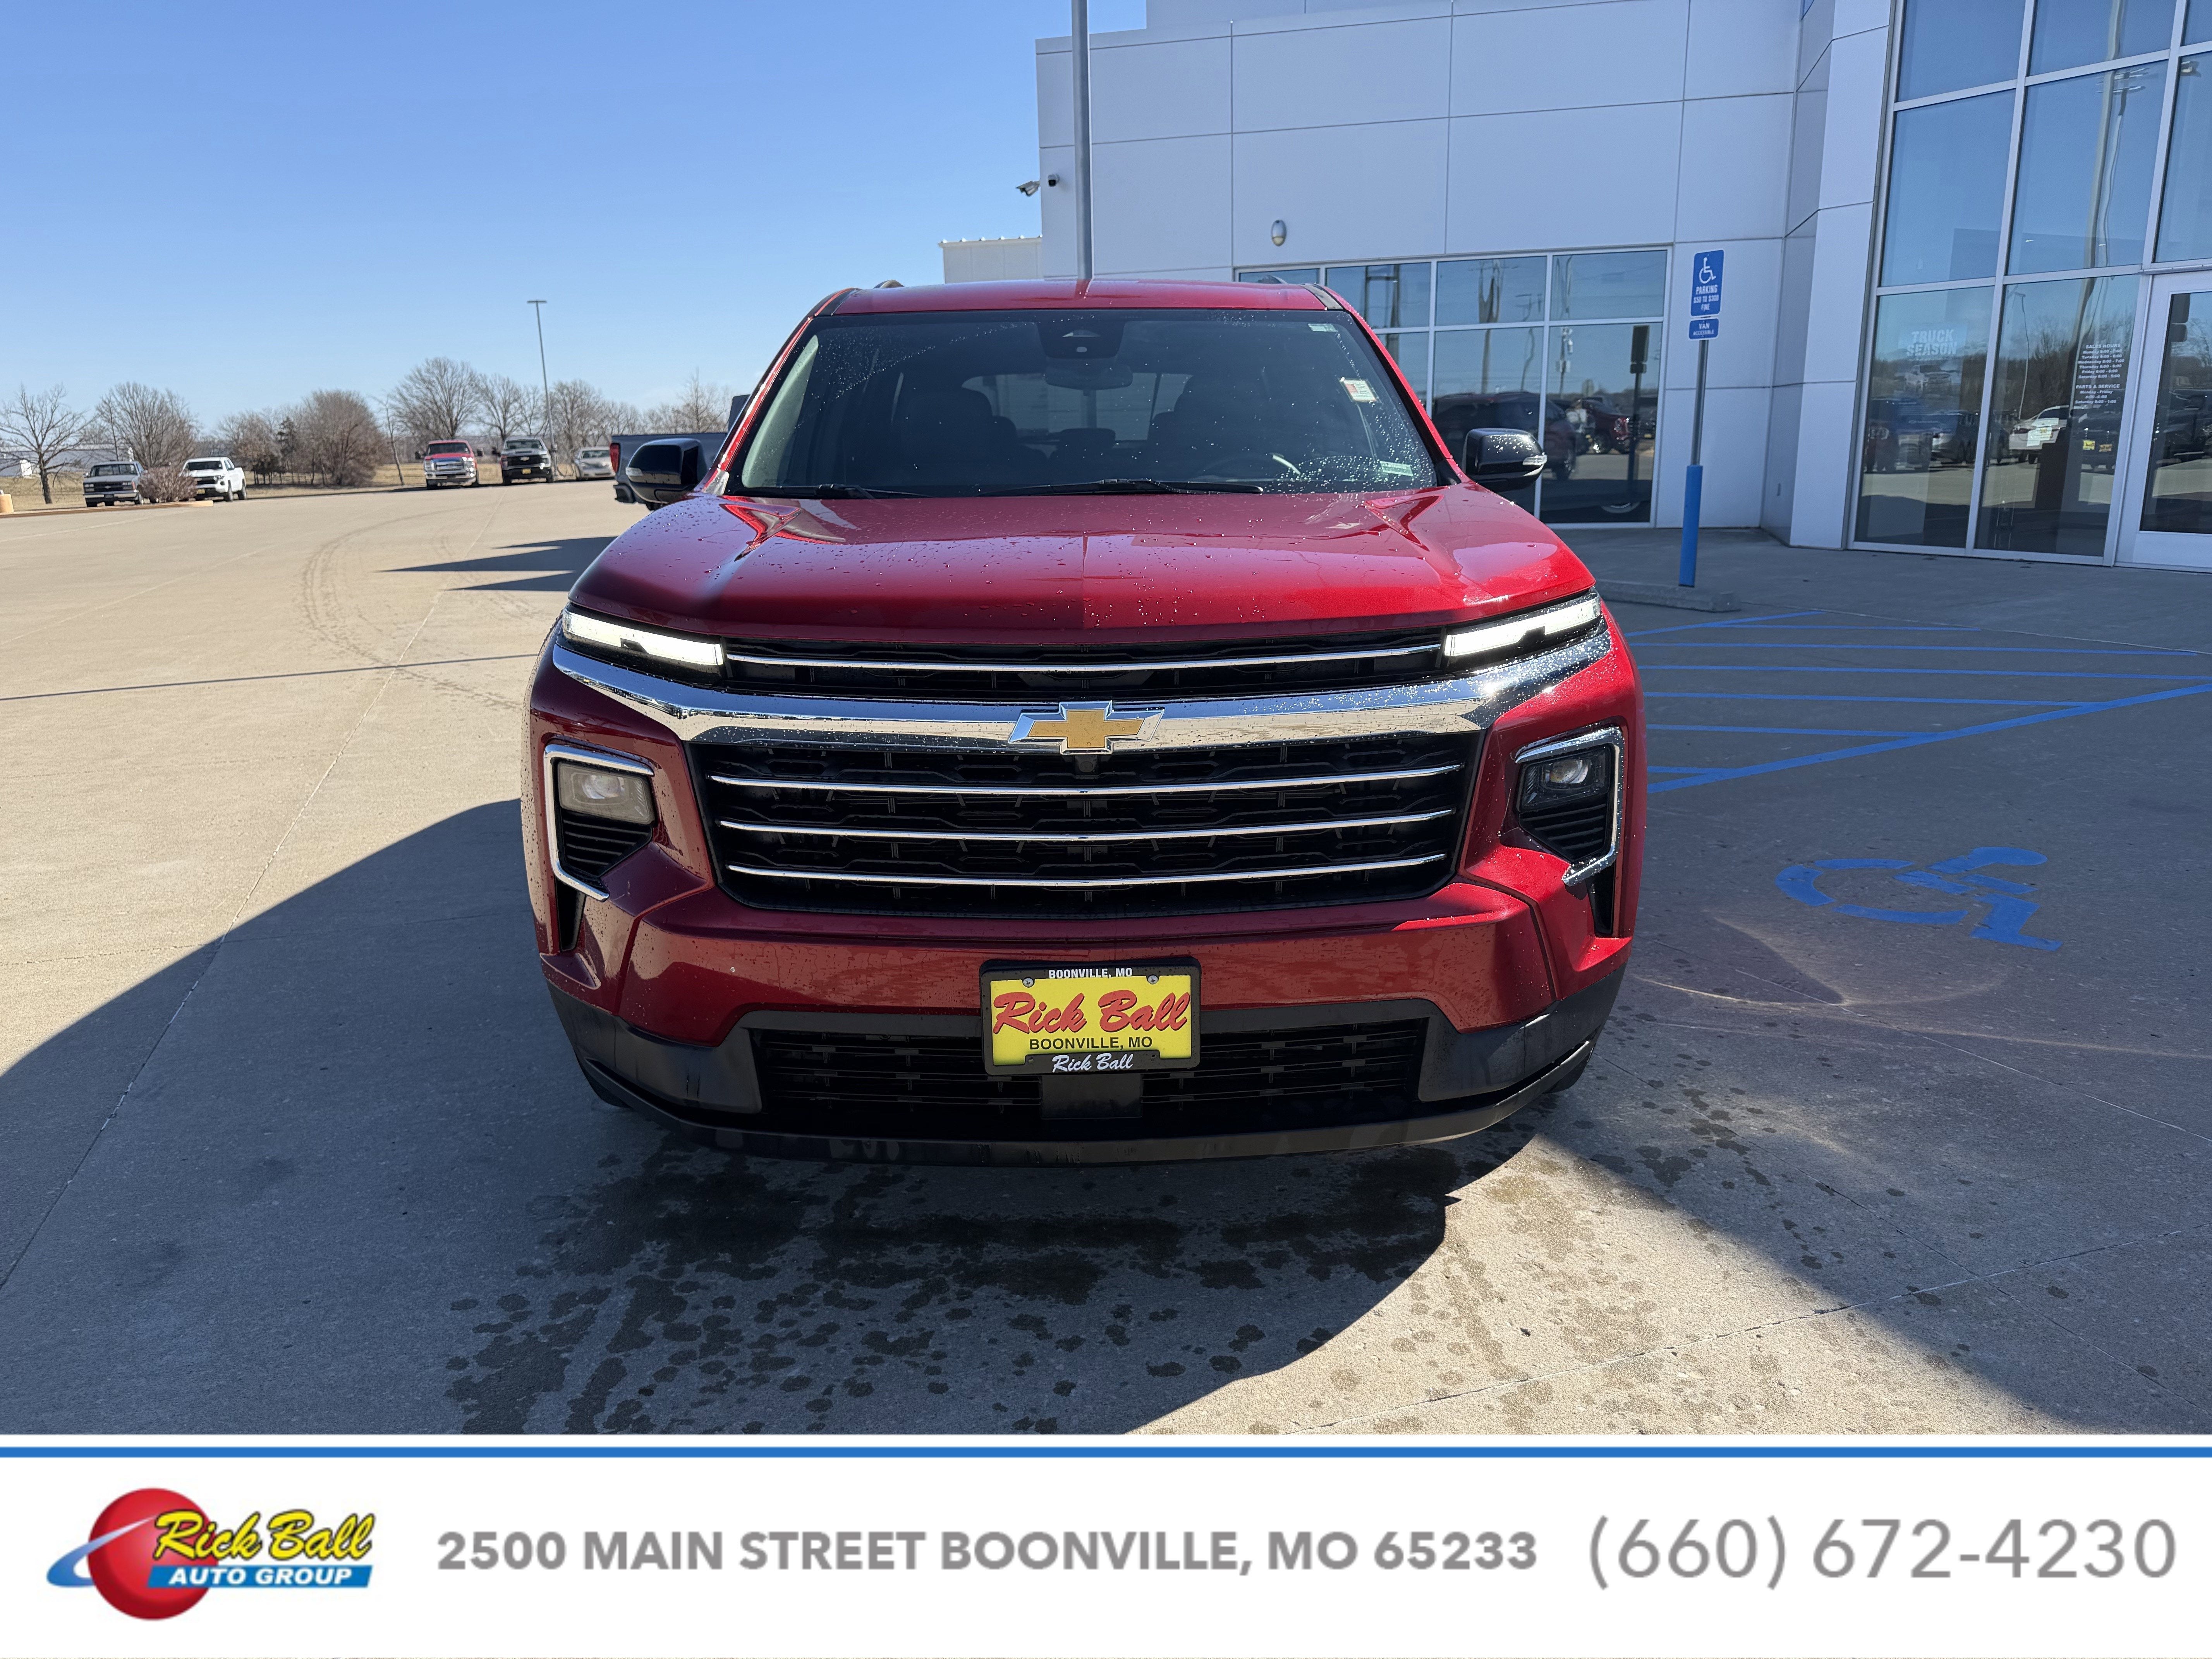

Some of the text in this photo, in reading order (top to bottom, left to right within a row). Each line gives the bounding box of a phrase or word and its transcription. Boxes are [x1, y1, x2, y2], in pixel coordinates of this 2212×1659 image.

[1696, 284, 1718, 294] PARKING
[1911, 329, 1954, 343] TRUCK
[1906, 342, 1957, 356] SEASON
[1048, 967, 1133, 979] BOONVILLE, MO
[993, 989, 1190, 1034] Rick Ball
[1029, 1037, 1152, 1050] BOONVILLE, MO
[1052, 1053, 1133, 1073] Rick Ball
